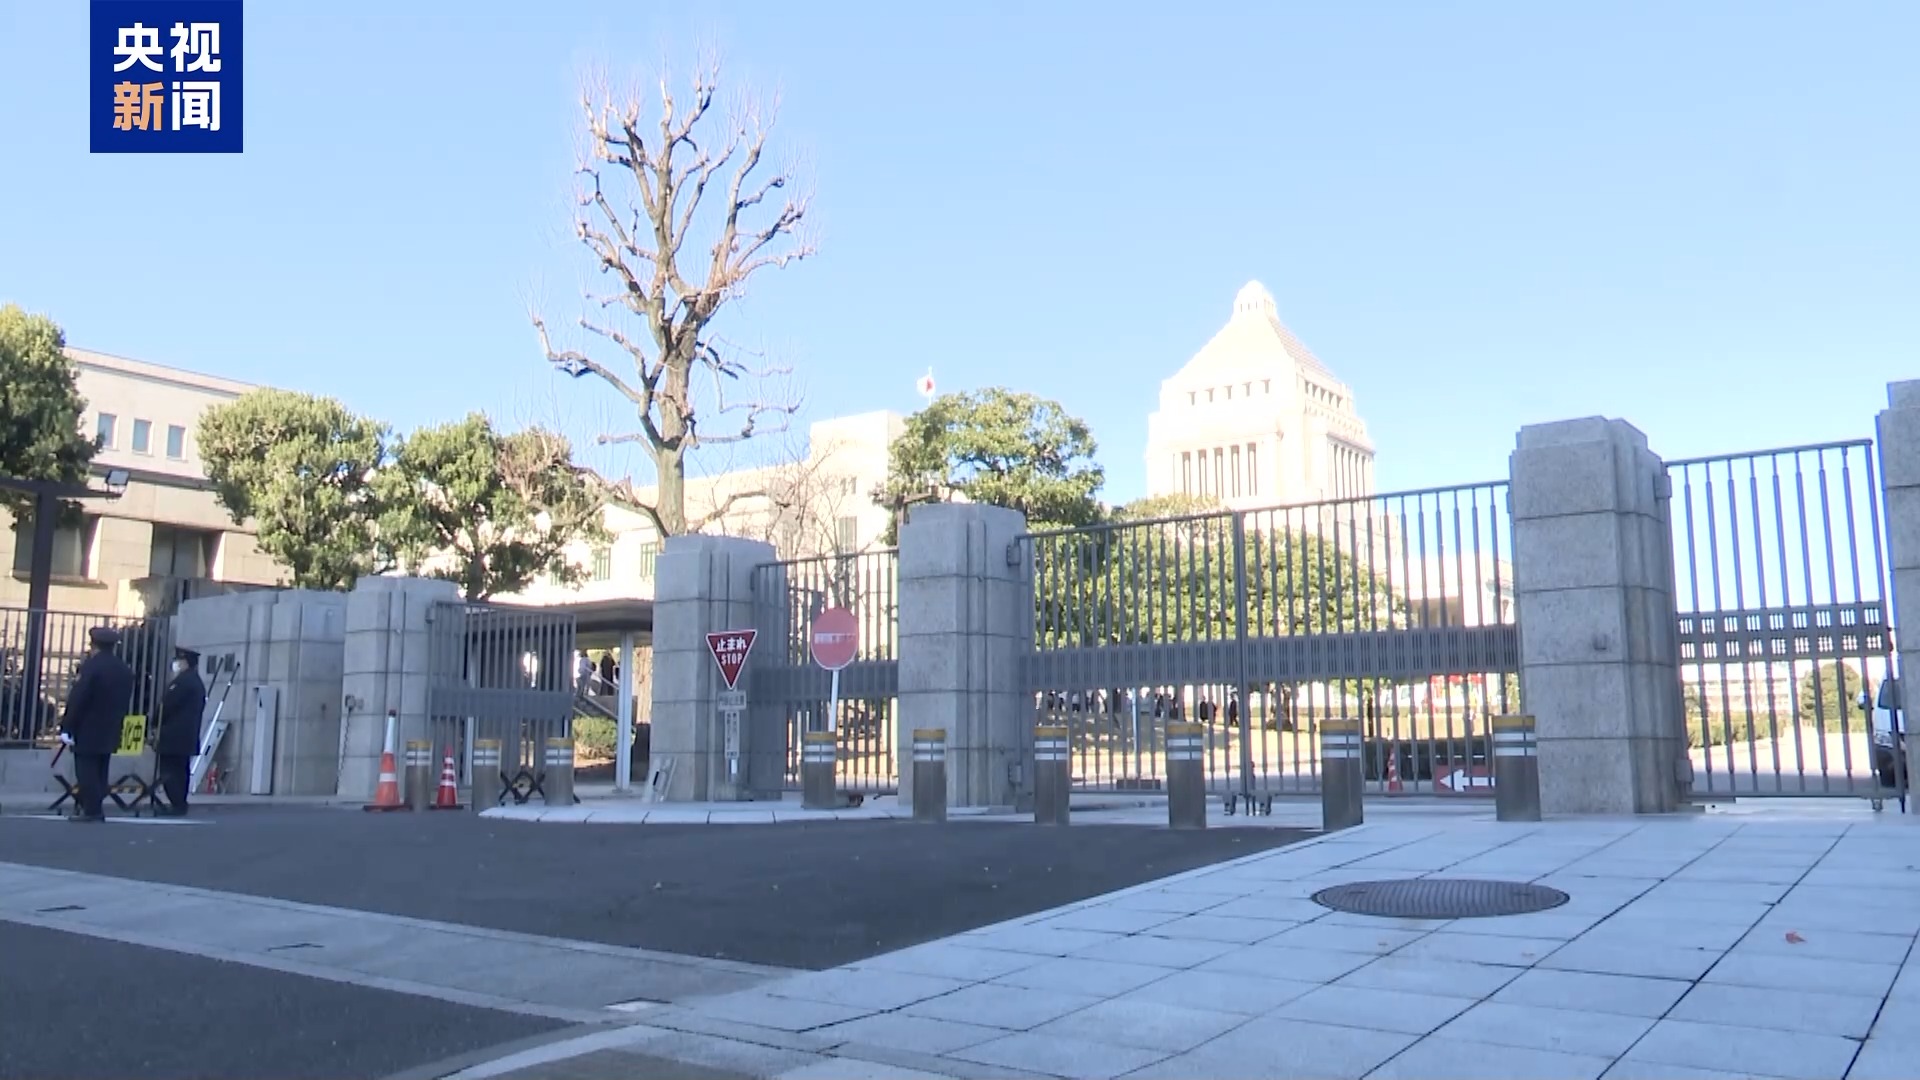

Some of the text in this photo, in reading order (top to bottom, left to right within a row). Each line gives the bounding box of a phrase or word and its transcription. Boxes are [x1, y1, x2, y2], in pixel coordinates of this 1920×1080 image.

[715, 636, 747, 653] 止まれ
[720, 653, 743, 666] STOP
